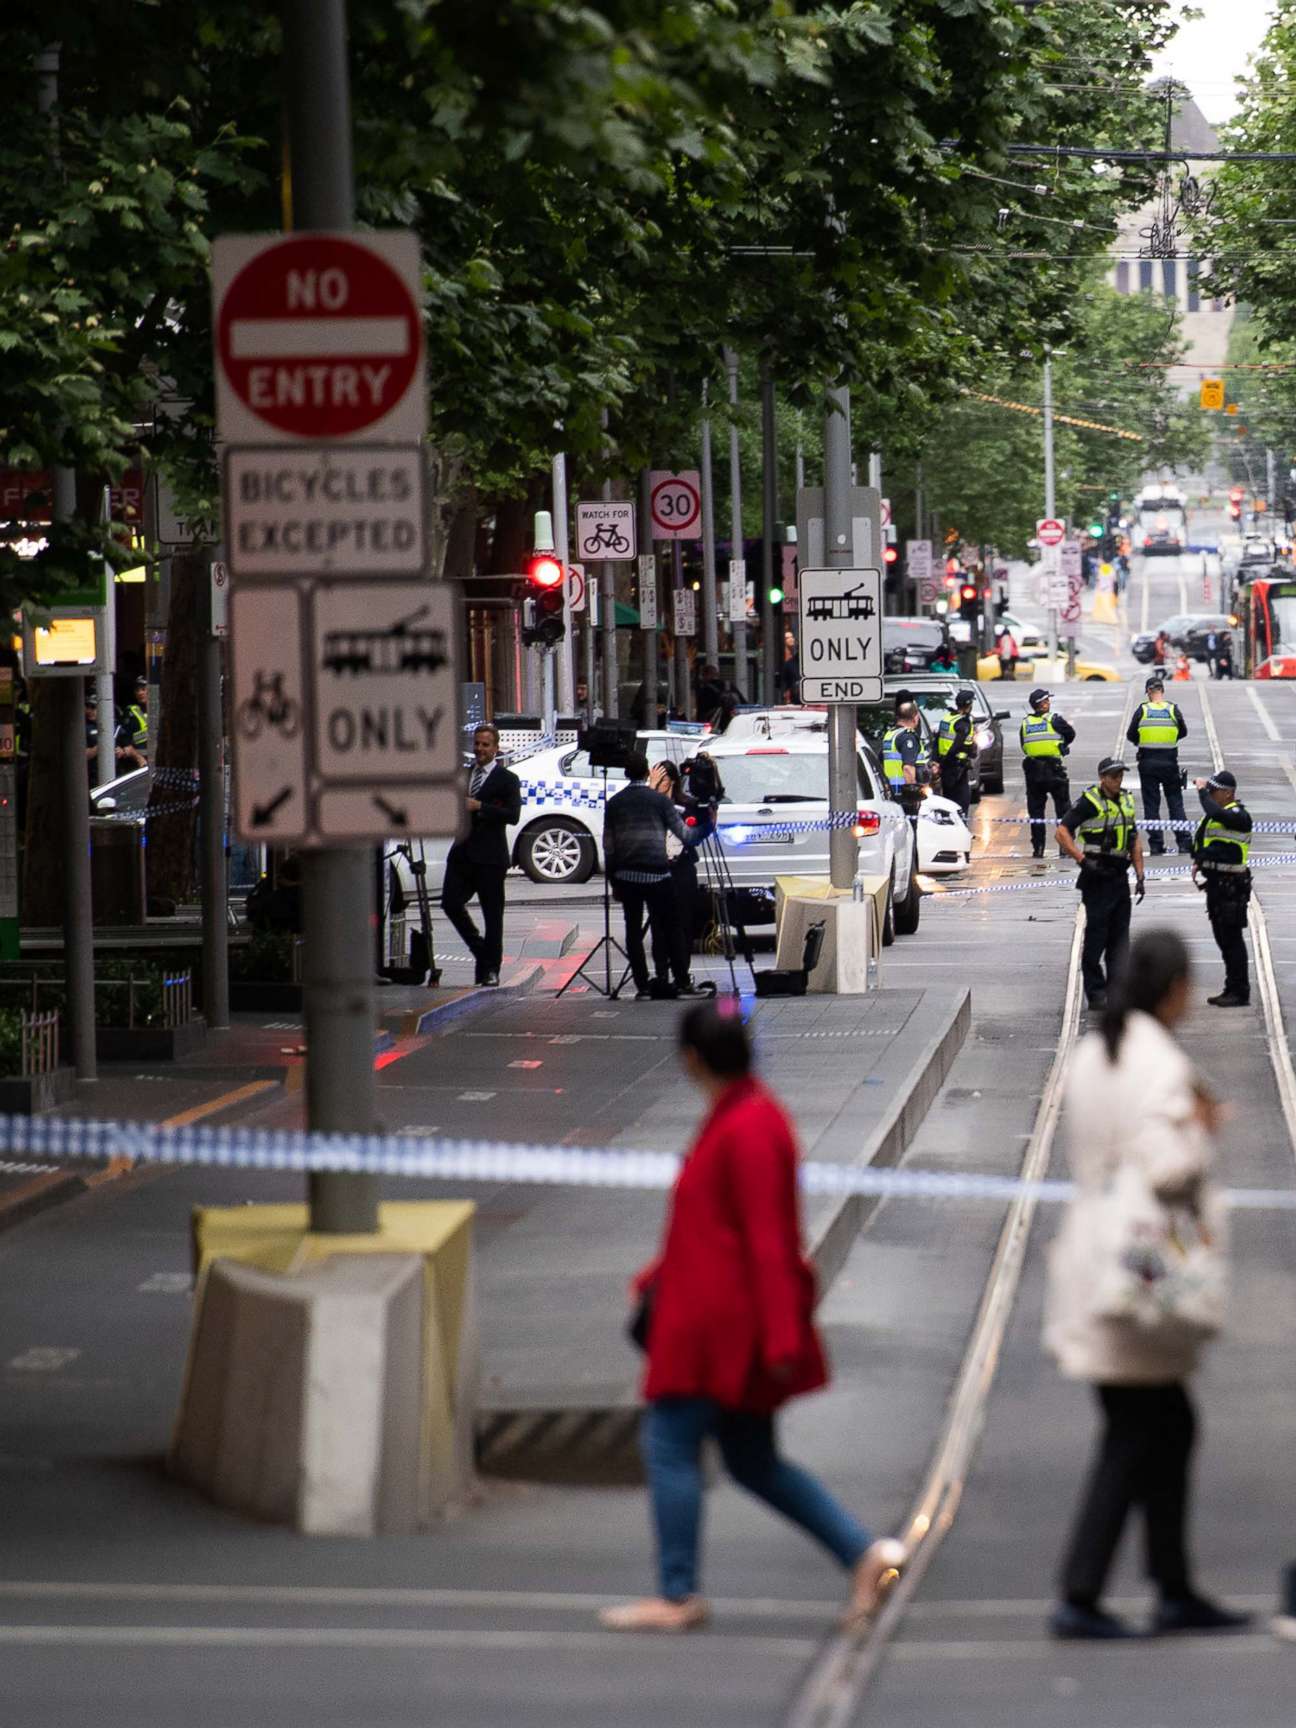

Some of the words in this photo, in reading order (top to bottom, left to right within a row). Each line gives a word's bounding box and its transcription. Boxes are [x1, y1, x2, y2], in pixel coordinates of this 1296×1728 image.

[285, 267, 348, 310] NO
[249, 364, 391, 408] ENTRY
[240, 468, 411, 501] BICYCLES
[581, 511, 609, 519] WATCH
[612, 510, 630, 518] FOR
[660, 494, 692, 516] 30
[238, 518, 417, 551] EXCEPTED
[810, 637, 872, 661] ONLY
[820, 682, 864, 698] END
[328, 705, 443, 752] ONLY
